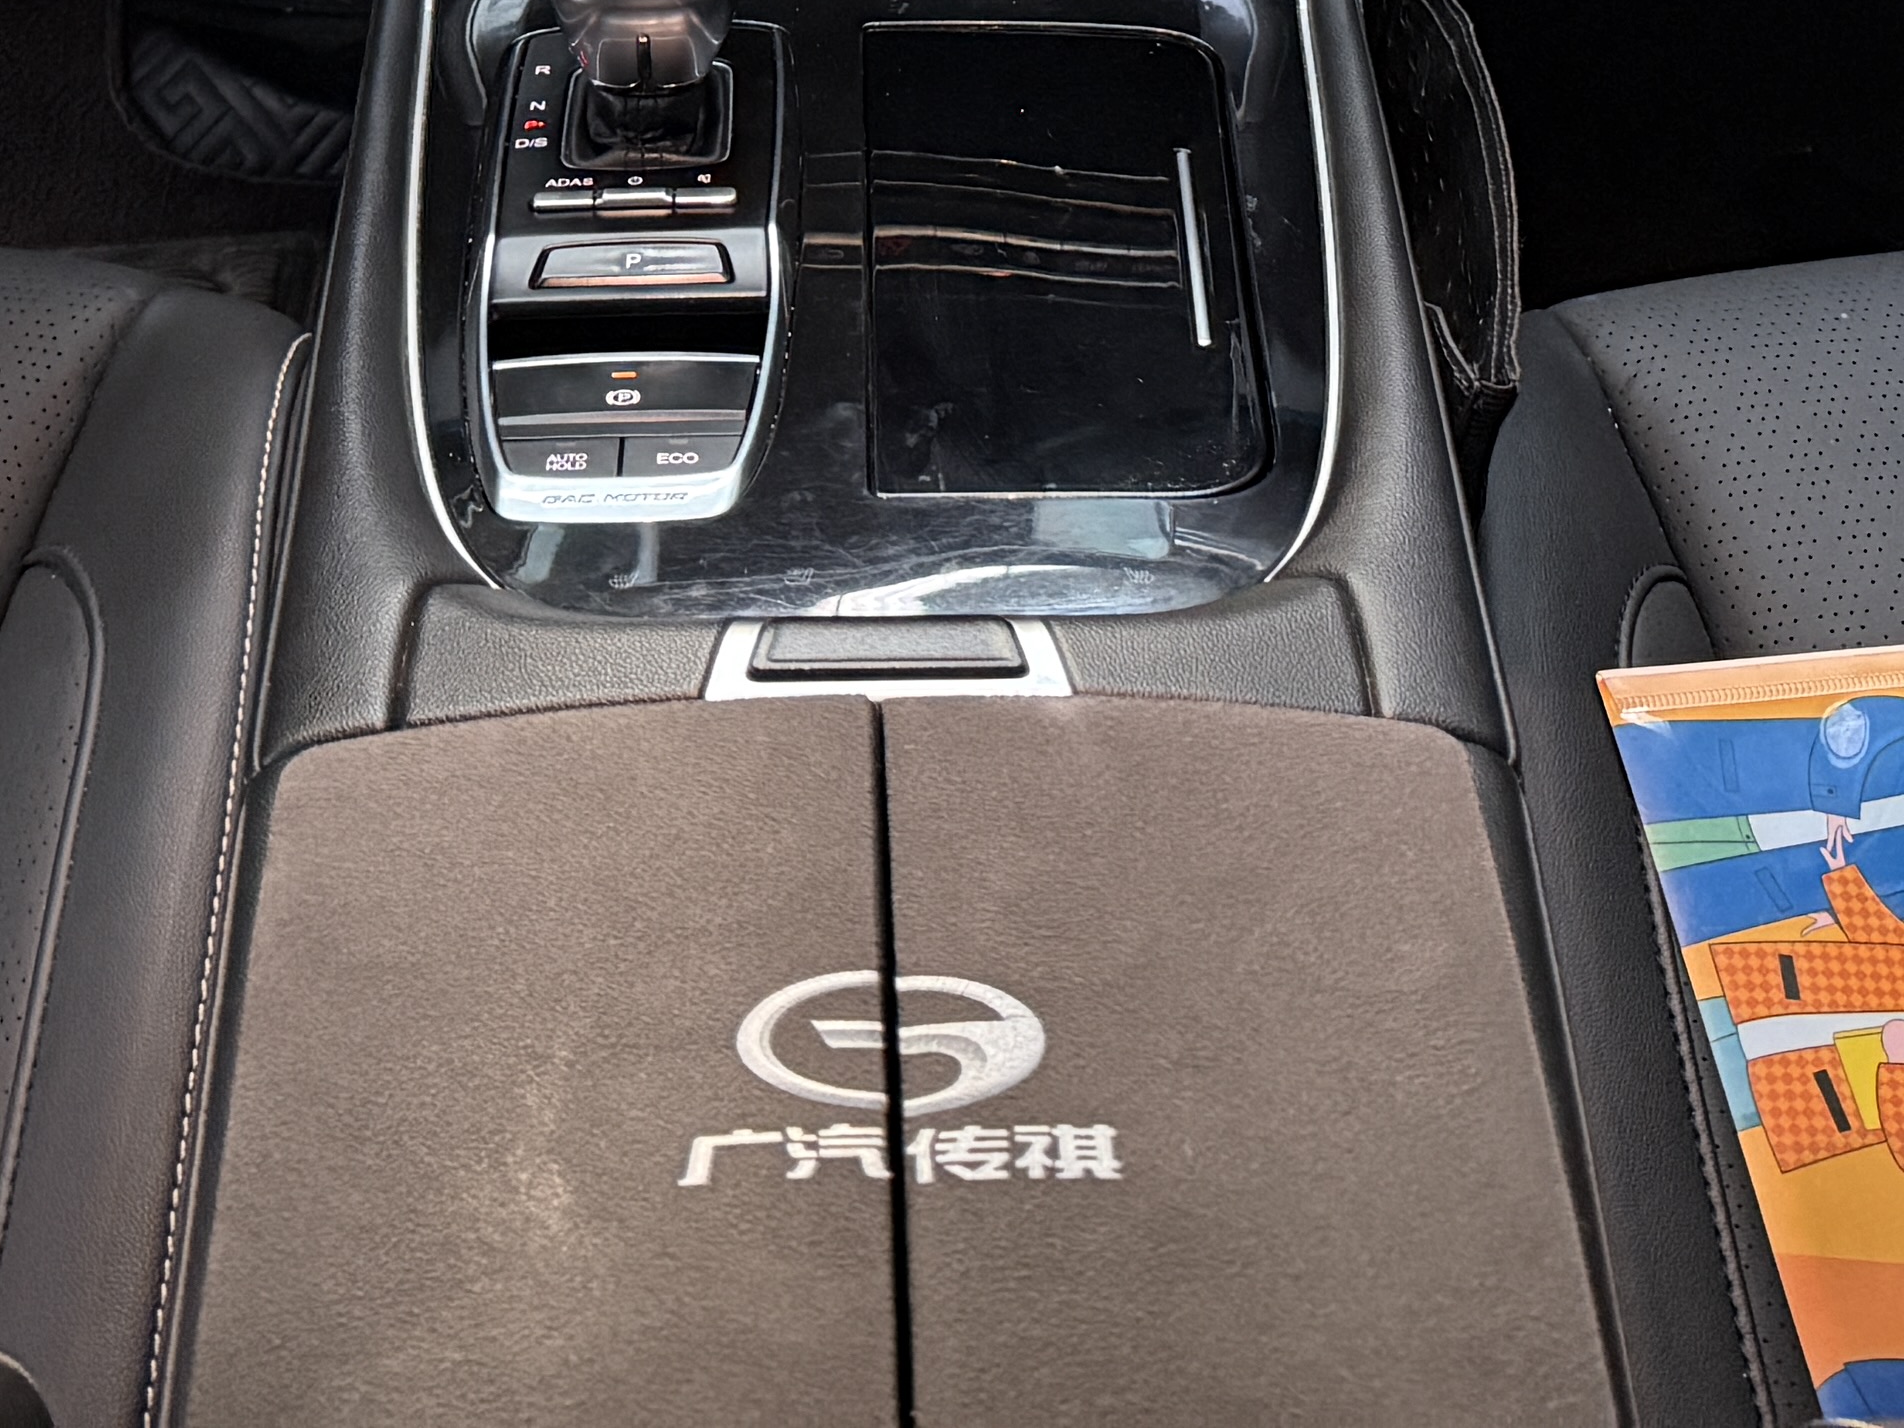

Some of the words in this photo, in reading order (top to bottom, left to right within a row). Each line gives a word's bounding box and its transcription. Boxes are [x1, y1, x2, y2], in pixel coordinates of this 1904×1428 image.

[534, 65, 551, 76] R
[529, 100, 546, 111] N
[514, 137, 549, 149] D/S
[545, 177, 594, 188] ADAS
[625, 253, 642, 270] P
[546, 452, 588, 462] AUTO
[656, 452, 700, 465] ECO
[545, 461, 587, 472] HOLD
[542, 494, 596, 504] GAC
[603, 492, 689, 503] MOTOR
[676, 1122, 1124, 1187] 广汽传祺
